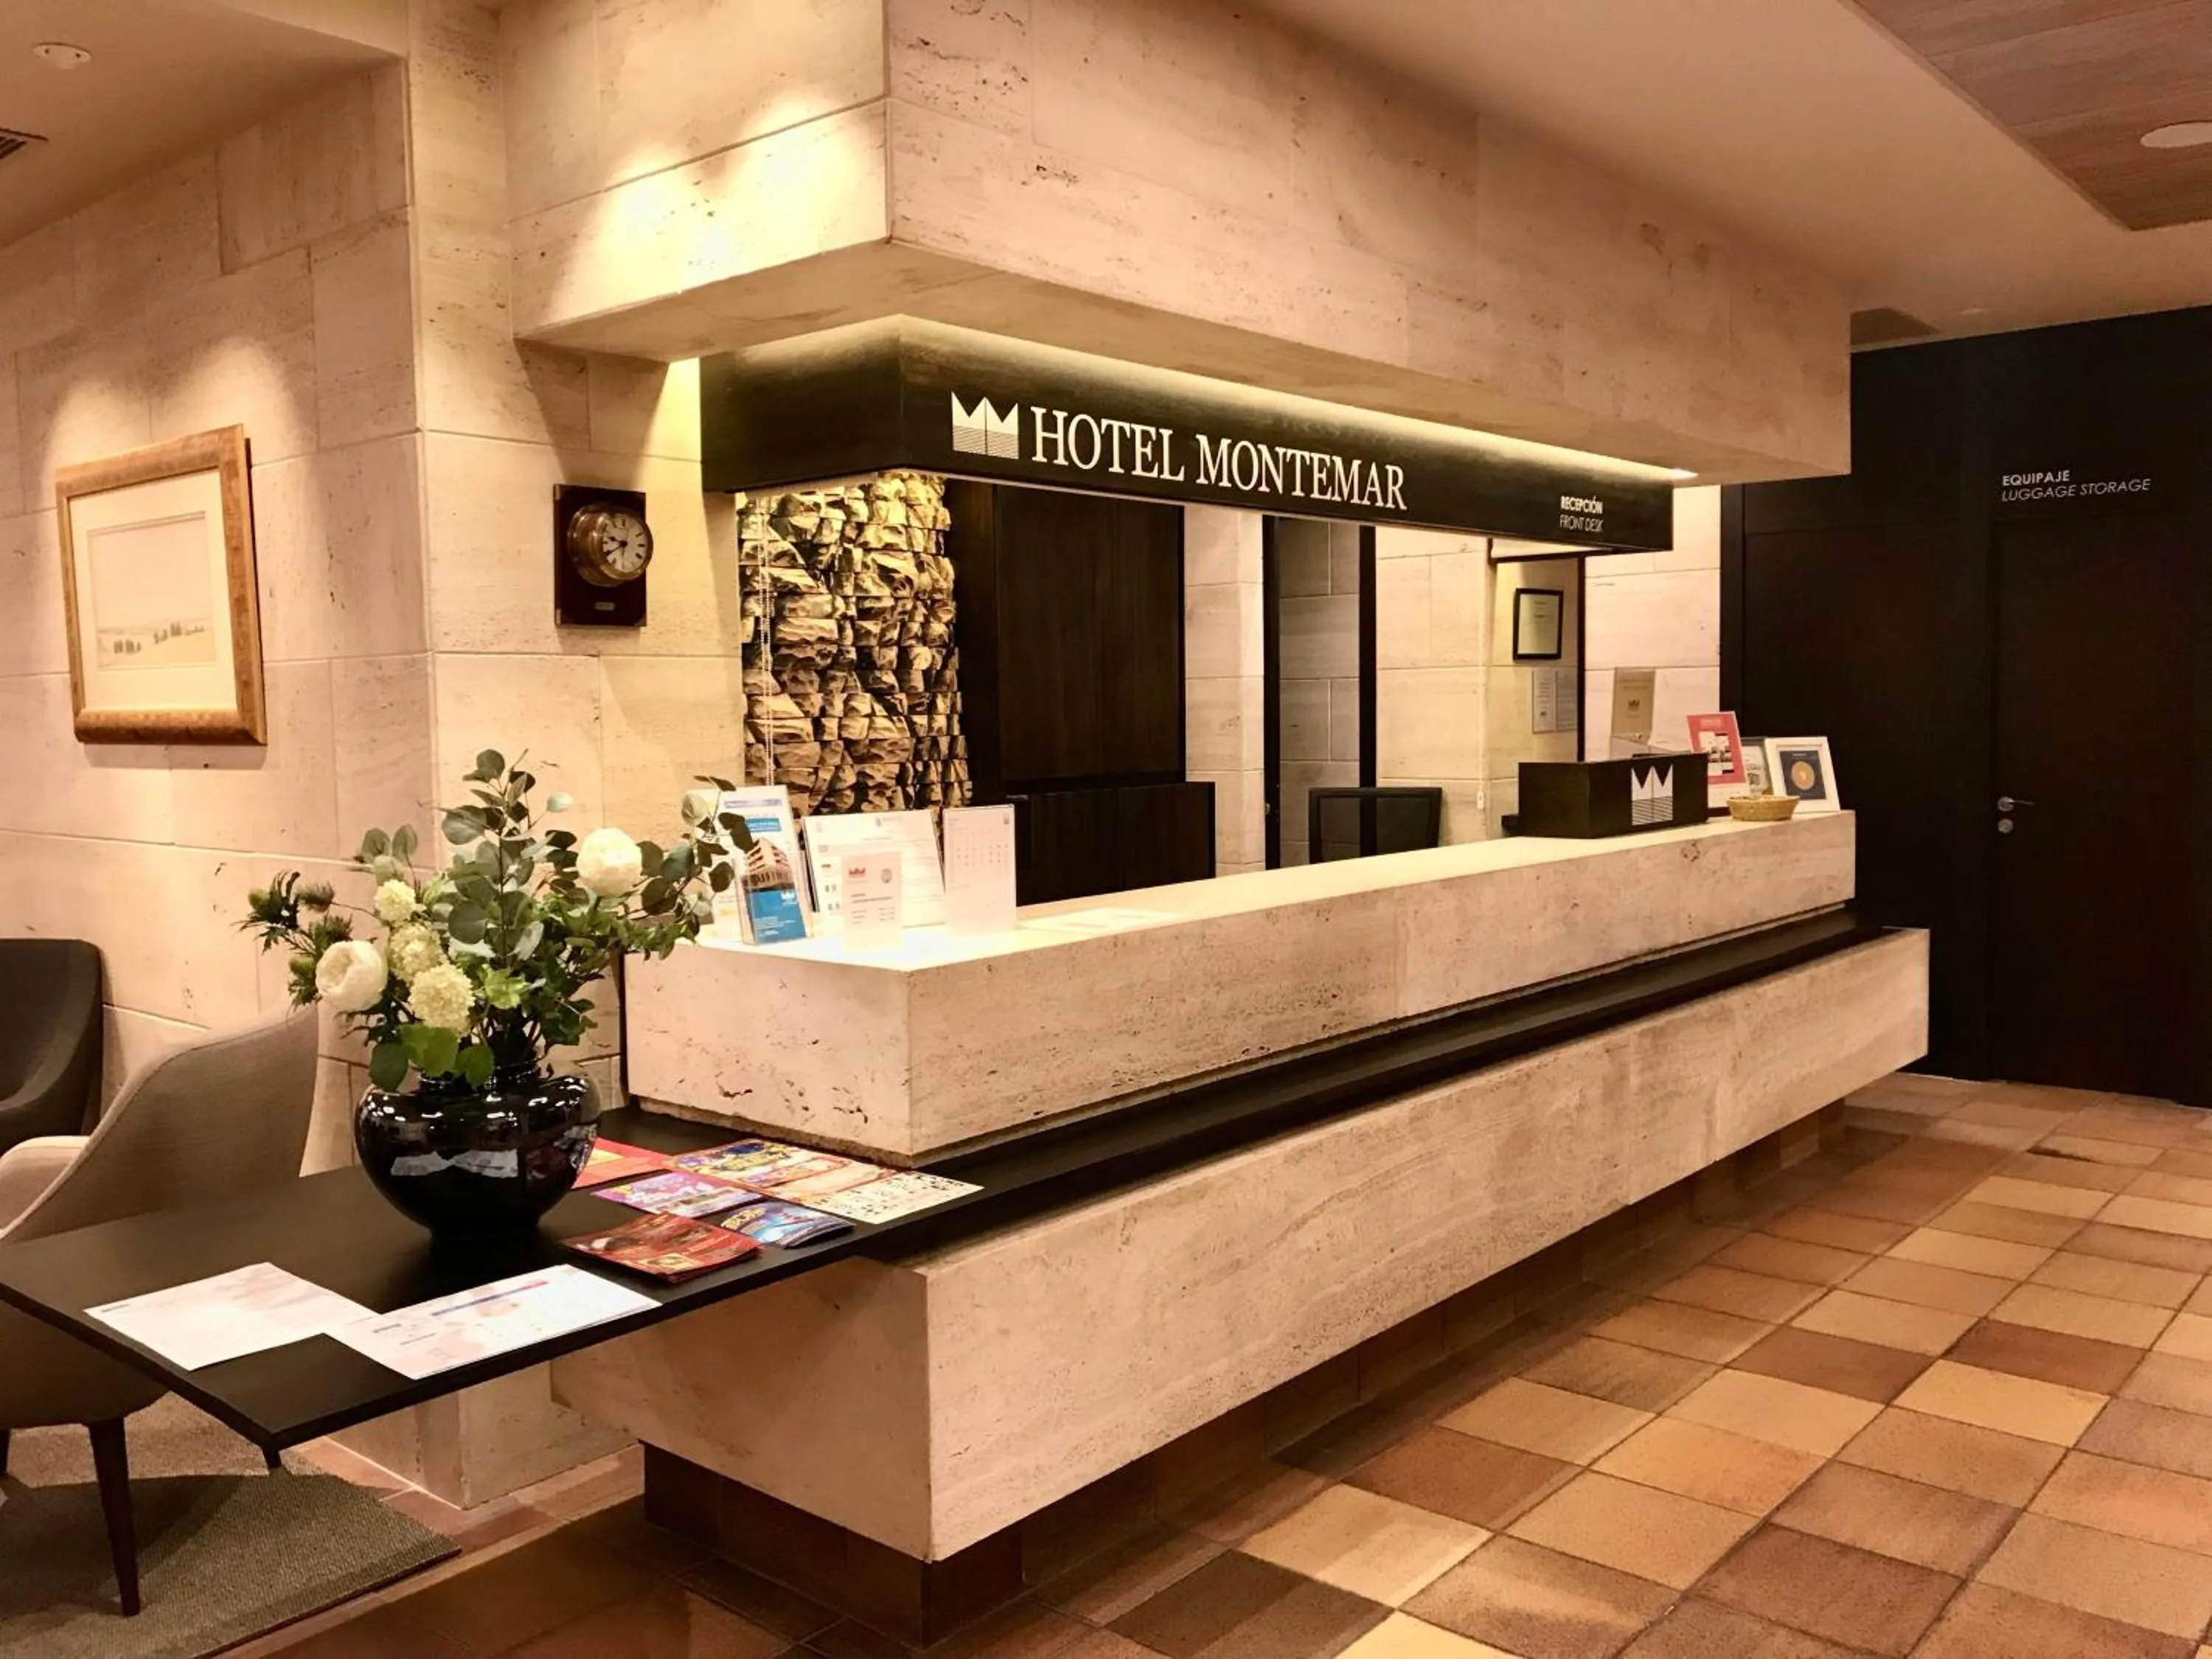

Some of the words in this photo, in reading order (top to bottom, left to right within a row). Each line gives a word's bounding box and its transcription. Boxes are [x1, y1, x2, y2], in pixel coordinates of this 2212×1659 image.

[1030, 406, 1185, 481] HOTEL
[1195, 434, 1408, 510] MONTEMAR
[2002, 470, 2070, 487] EQUIPAJE
[2002, 484, 2076, 501] LUGGAGE
[2079, 479, 2152, 495] STORAGE
[1559, 514, 1585, 530] FRONT
[1585, 518, 1604, 532] DESK
